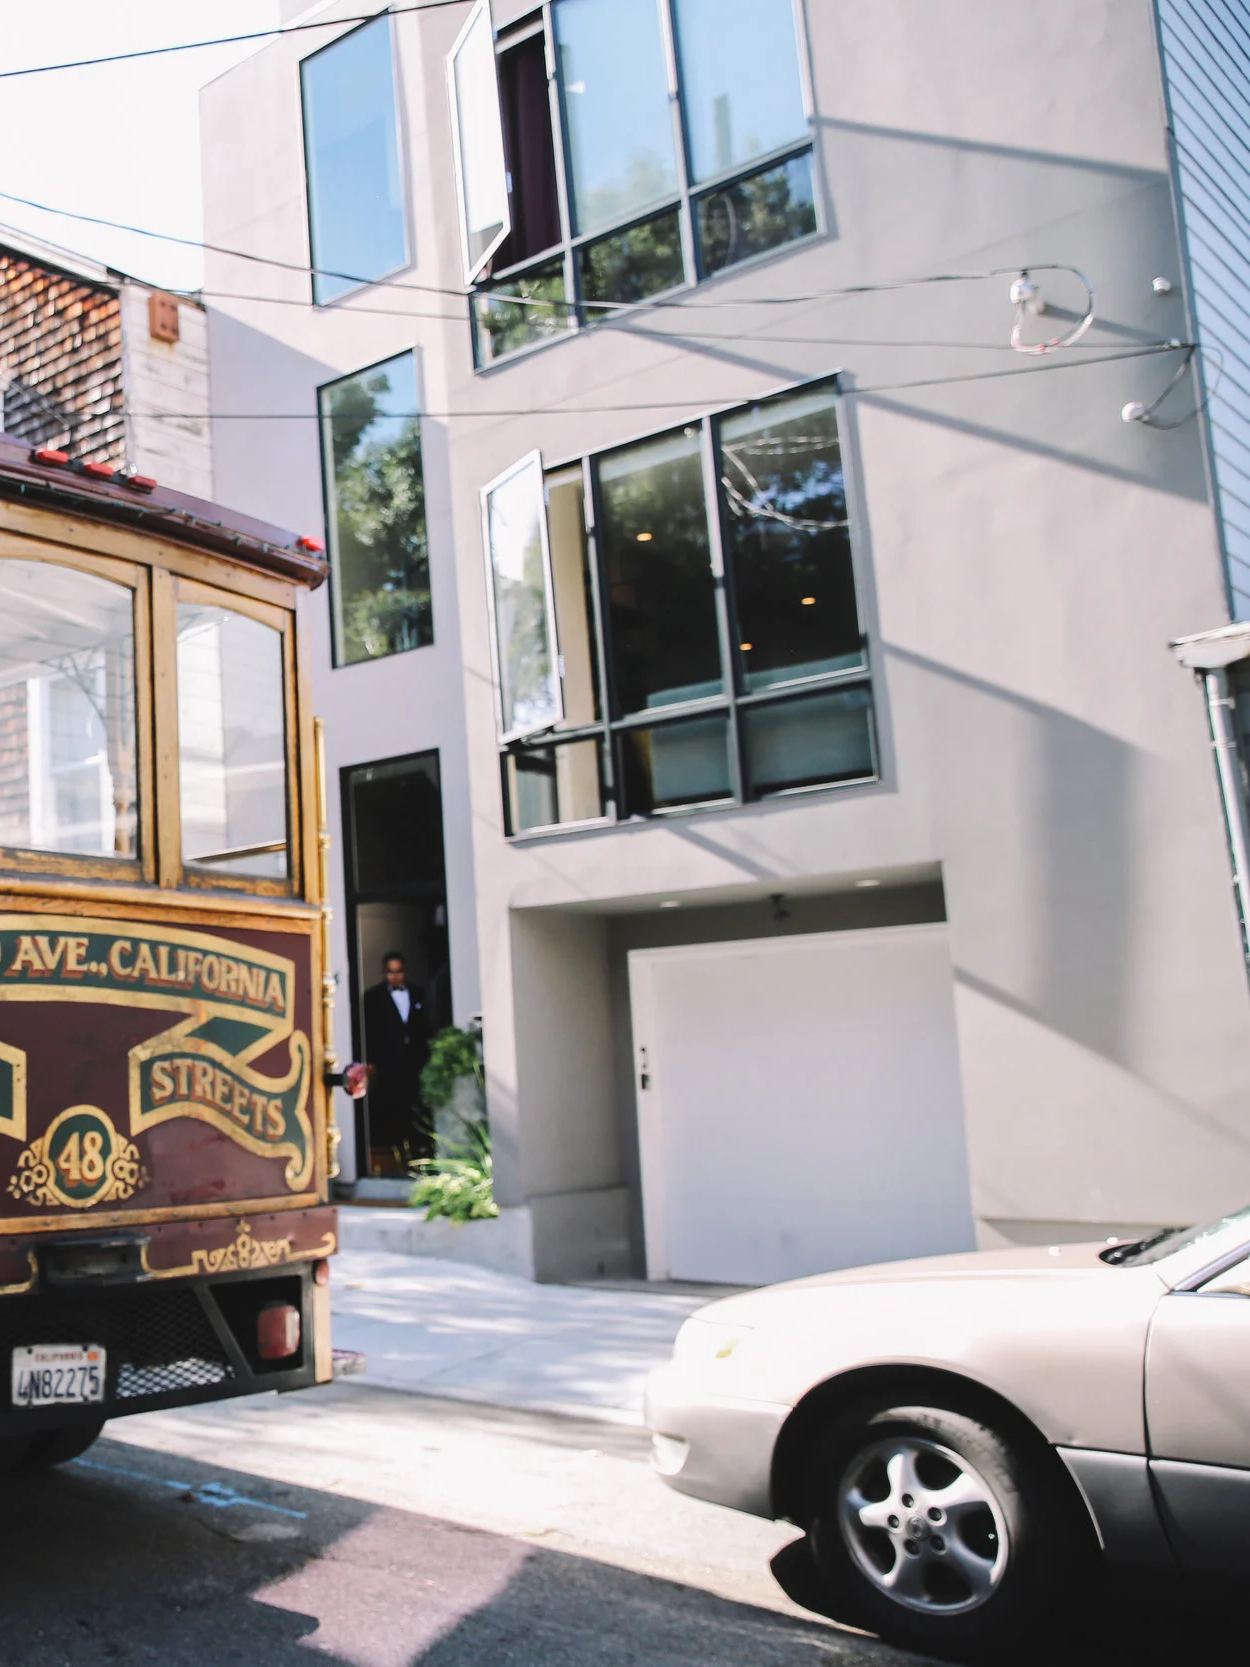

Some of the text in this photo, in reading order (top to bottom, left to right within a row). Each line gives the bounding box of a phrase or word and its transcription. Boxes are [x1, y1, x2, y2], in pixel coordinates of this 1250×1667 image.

[108, 939, 286, 1013] CALIFORNIA
[151, 1058, 286, 1139] STREETS
[57, 1131, 104, 1187] 48
[17, 1366, 100, 1399] 4N82275
